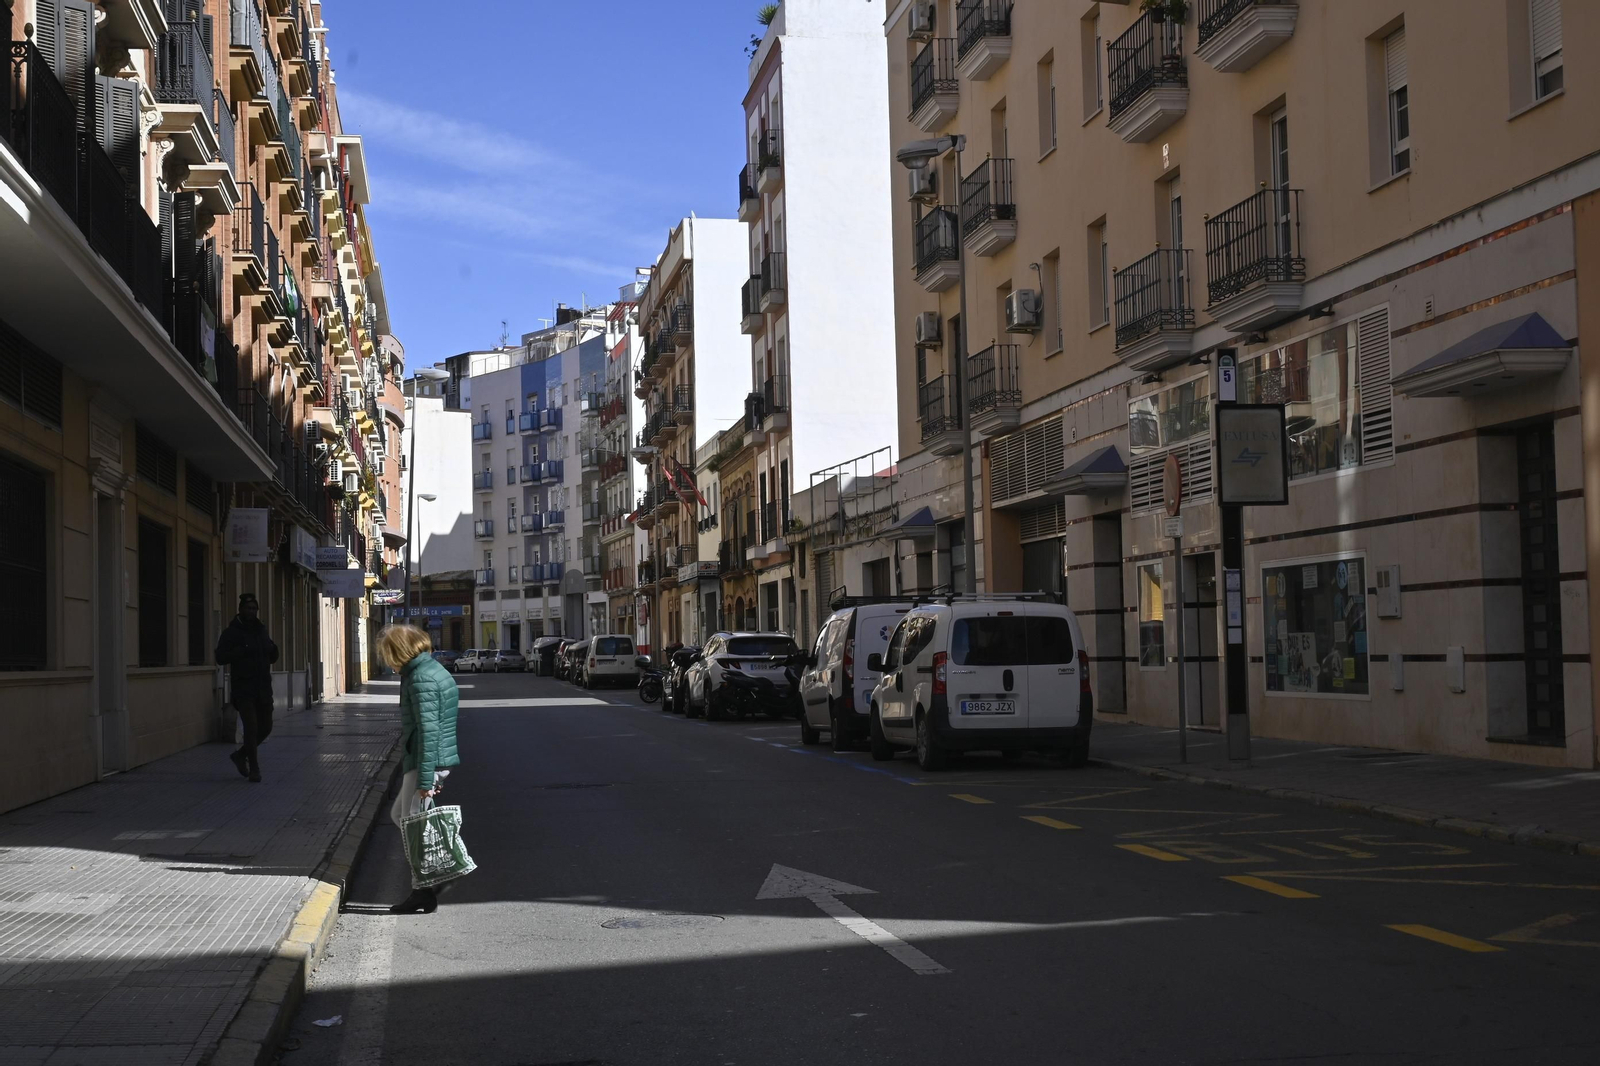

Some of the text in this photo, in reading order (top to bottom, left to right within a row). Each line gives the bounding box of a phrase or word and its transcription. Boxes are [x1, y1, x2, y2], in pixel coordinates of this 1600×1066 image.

[1223, 370, 1231, 382] 5
[1224, 431, 1278, 441] EMTUSA
[968, 702, 1012, 712] 9862 JZX
[1149, 834, 1472, 864] BUS
